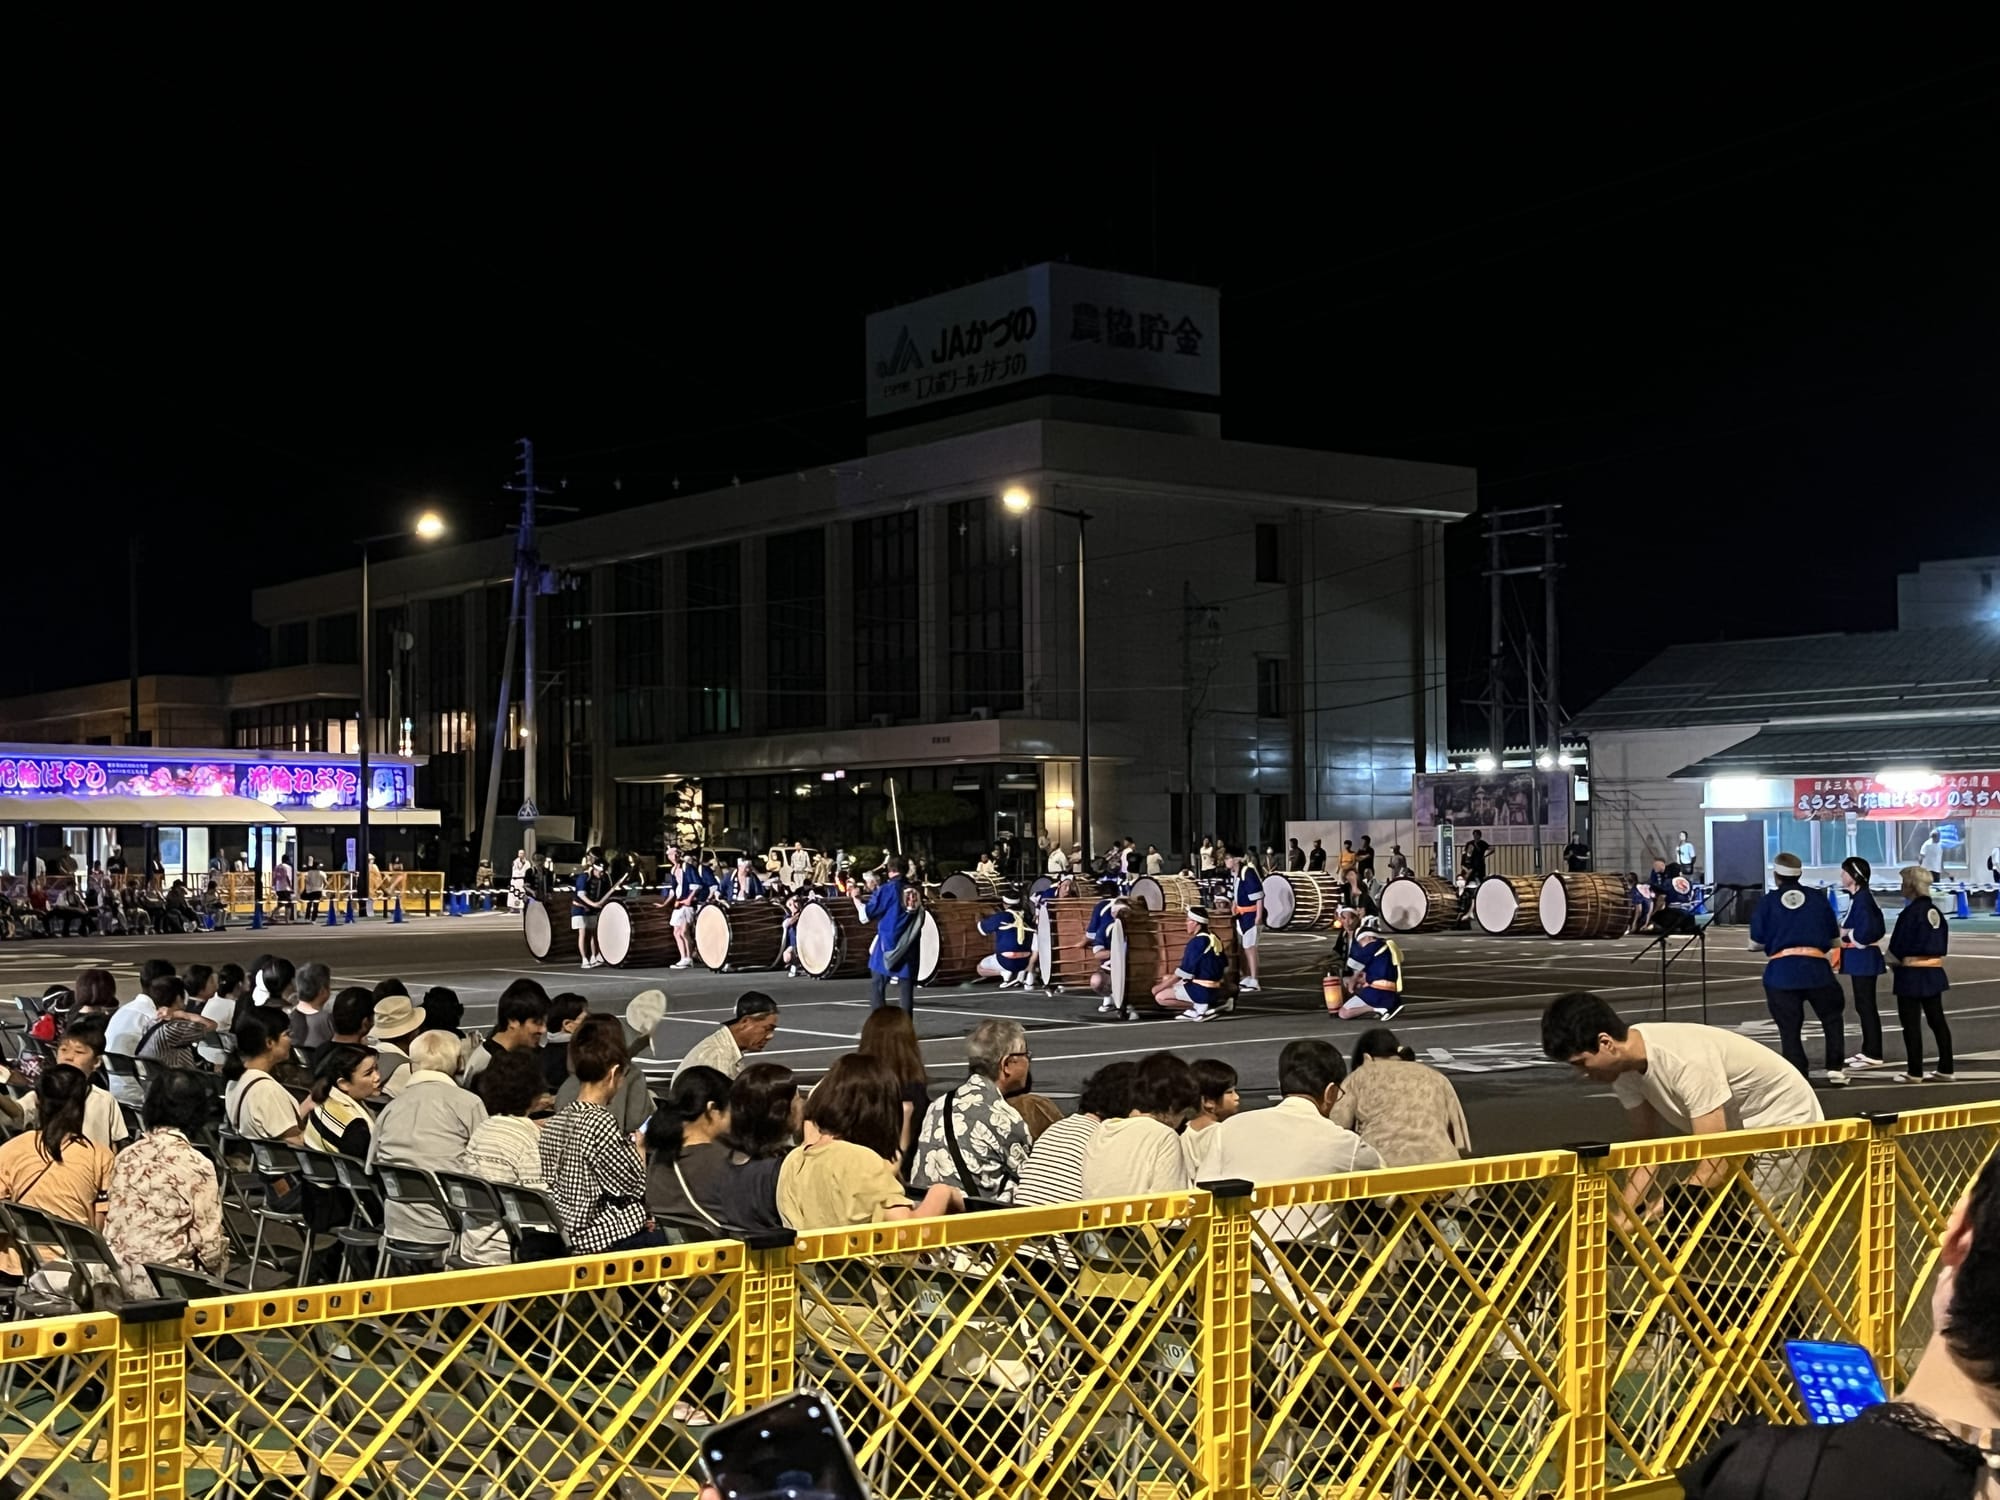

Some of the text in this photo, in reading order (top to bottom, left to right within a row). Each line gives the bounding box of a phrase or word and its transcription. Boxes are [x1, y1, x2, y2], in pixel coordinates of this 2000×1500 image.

[931, 306, 1037, 363] JAかづの
[1071, 302, 1202, 356] 農協貯金
[249, 766, 356, 793] 花輪ねぷた
